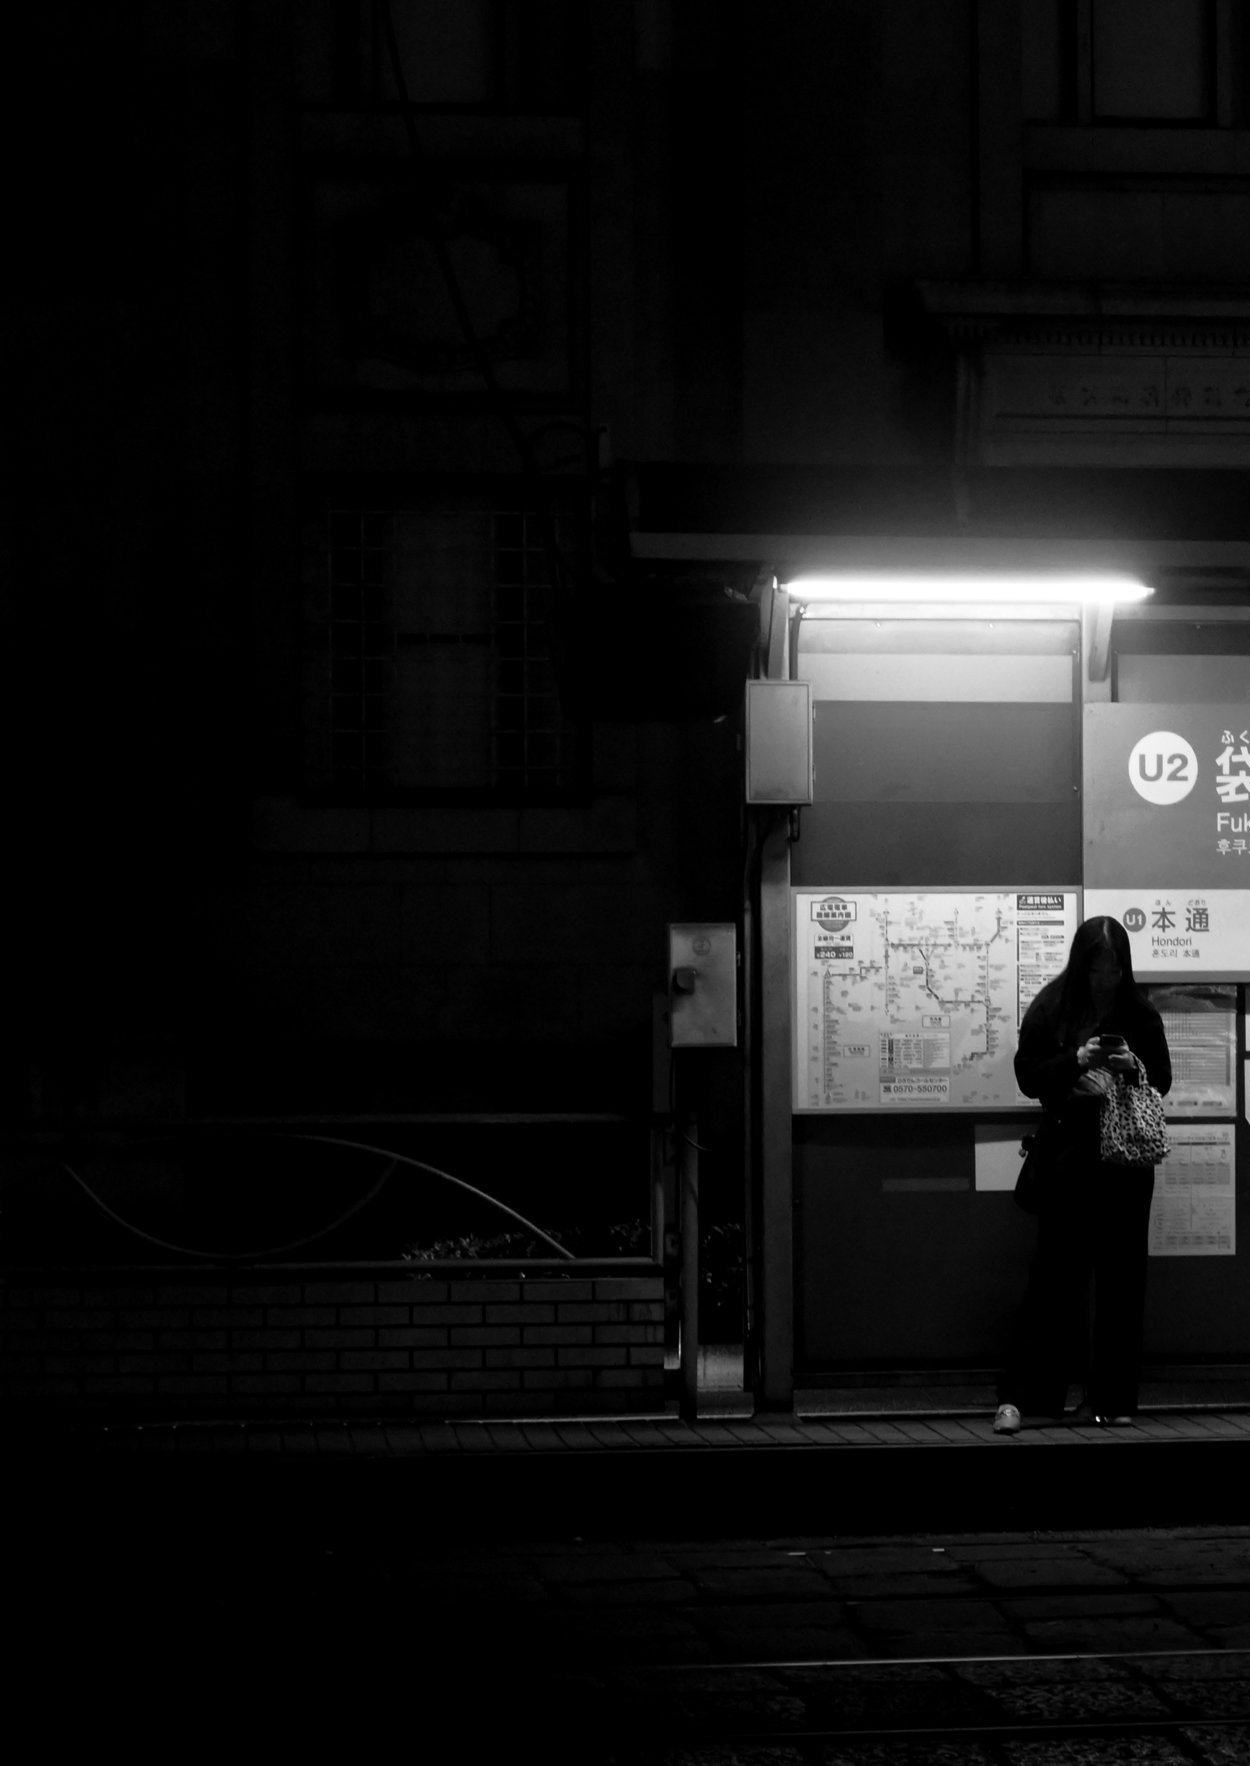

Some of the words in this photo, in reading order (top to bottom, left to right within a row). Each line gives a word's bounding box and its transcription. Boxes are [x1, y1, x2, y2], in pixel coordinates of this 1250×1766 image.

[1138, 753, 1189, 783] U2
[1125, 914, 1143, 926] U1
[1151, 906, 1210, 934] 本通
[1151, 936, 1193, 947] Hondori
